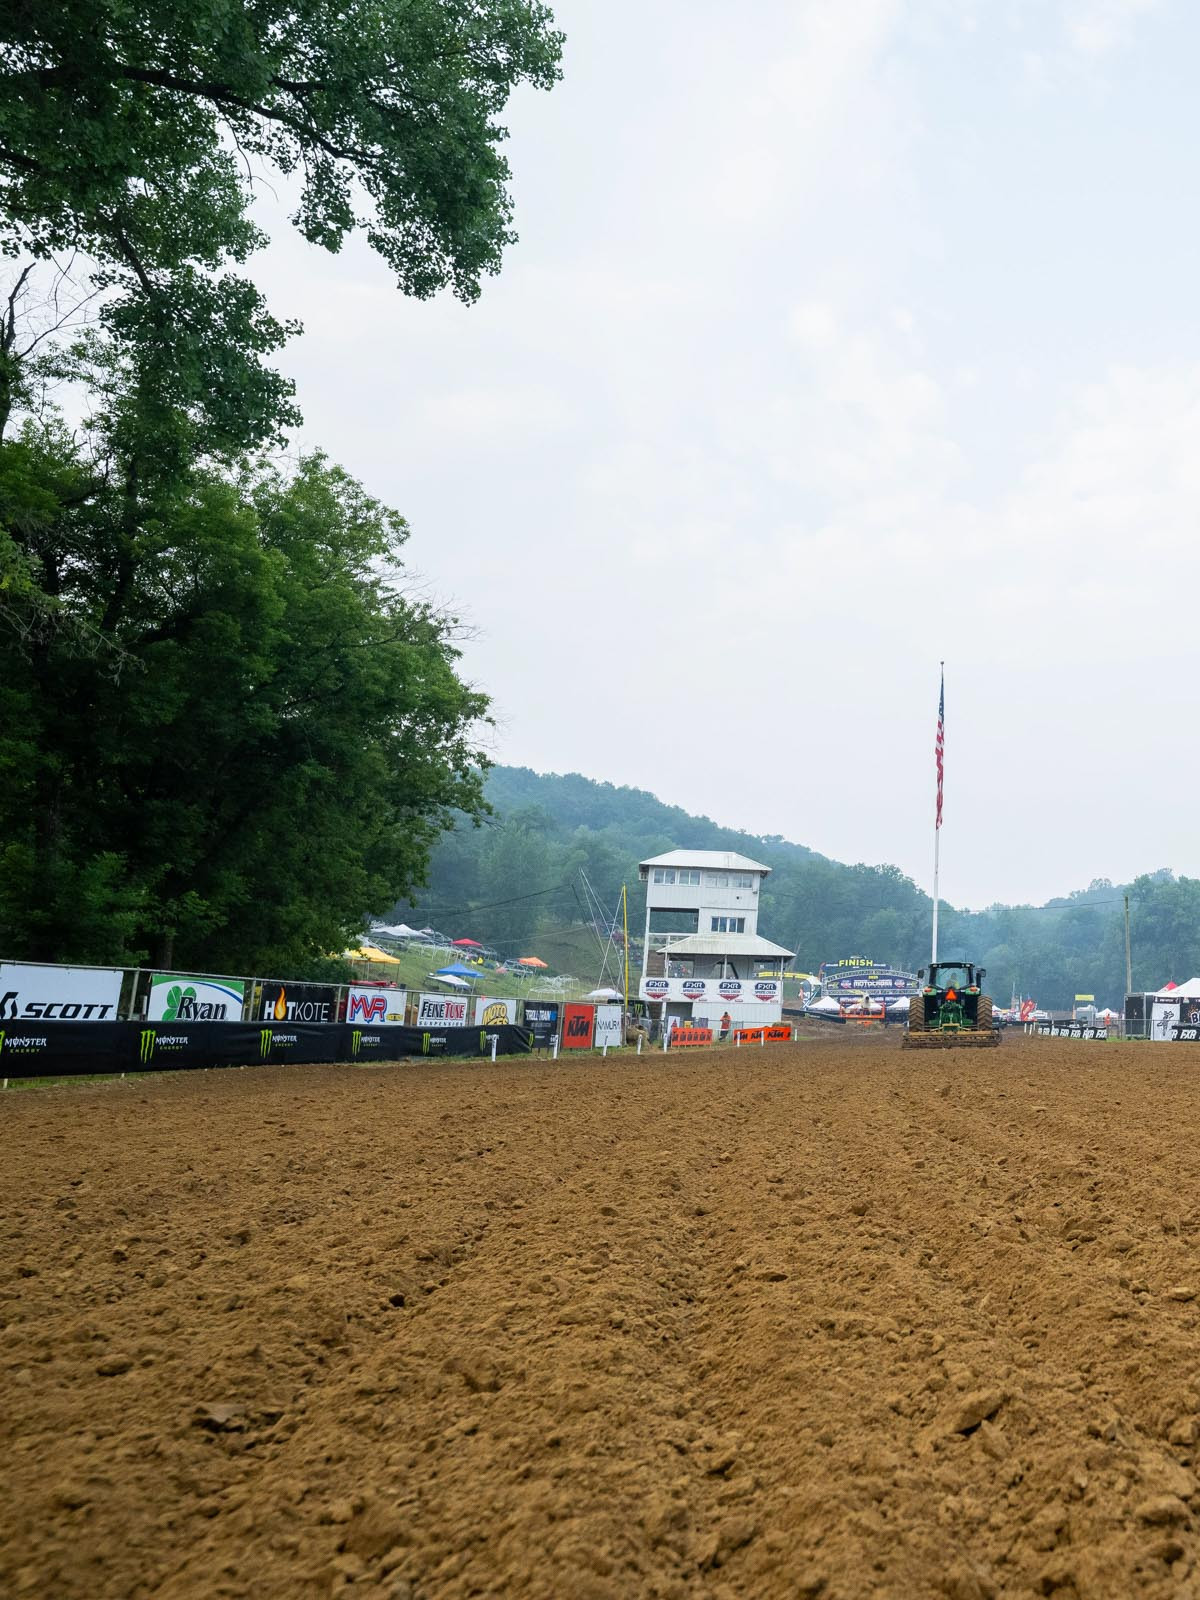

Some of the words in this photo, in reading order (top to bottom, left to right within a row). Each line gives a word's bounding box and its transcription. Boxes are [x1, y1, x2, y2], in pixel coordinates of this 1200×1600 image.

[838, 959, 874, 967] FINISH
[21, 1003, 113, 1019] SCOTT
[175, 996, 228, 1021] Ryan
[349, 994, 388, 1023] MVR
[483, 1003, 507, 1024] MOTO
[567, 1016, 590, 1037] KTM
[155, 1034, 189, 1045] MONSTER
[272, 1034, 297, 1042] MONSTER
[767, 1030, 783, 1038] KTM
[1180, 1030, 1197, 1039] FXR
[4, 1036, 47, 1047] MONSTER
